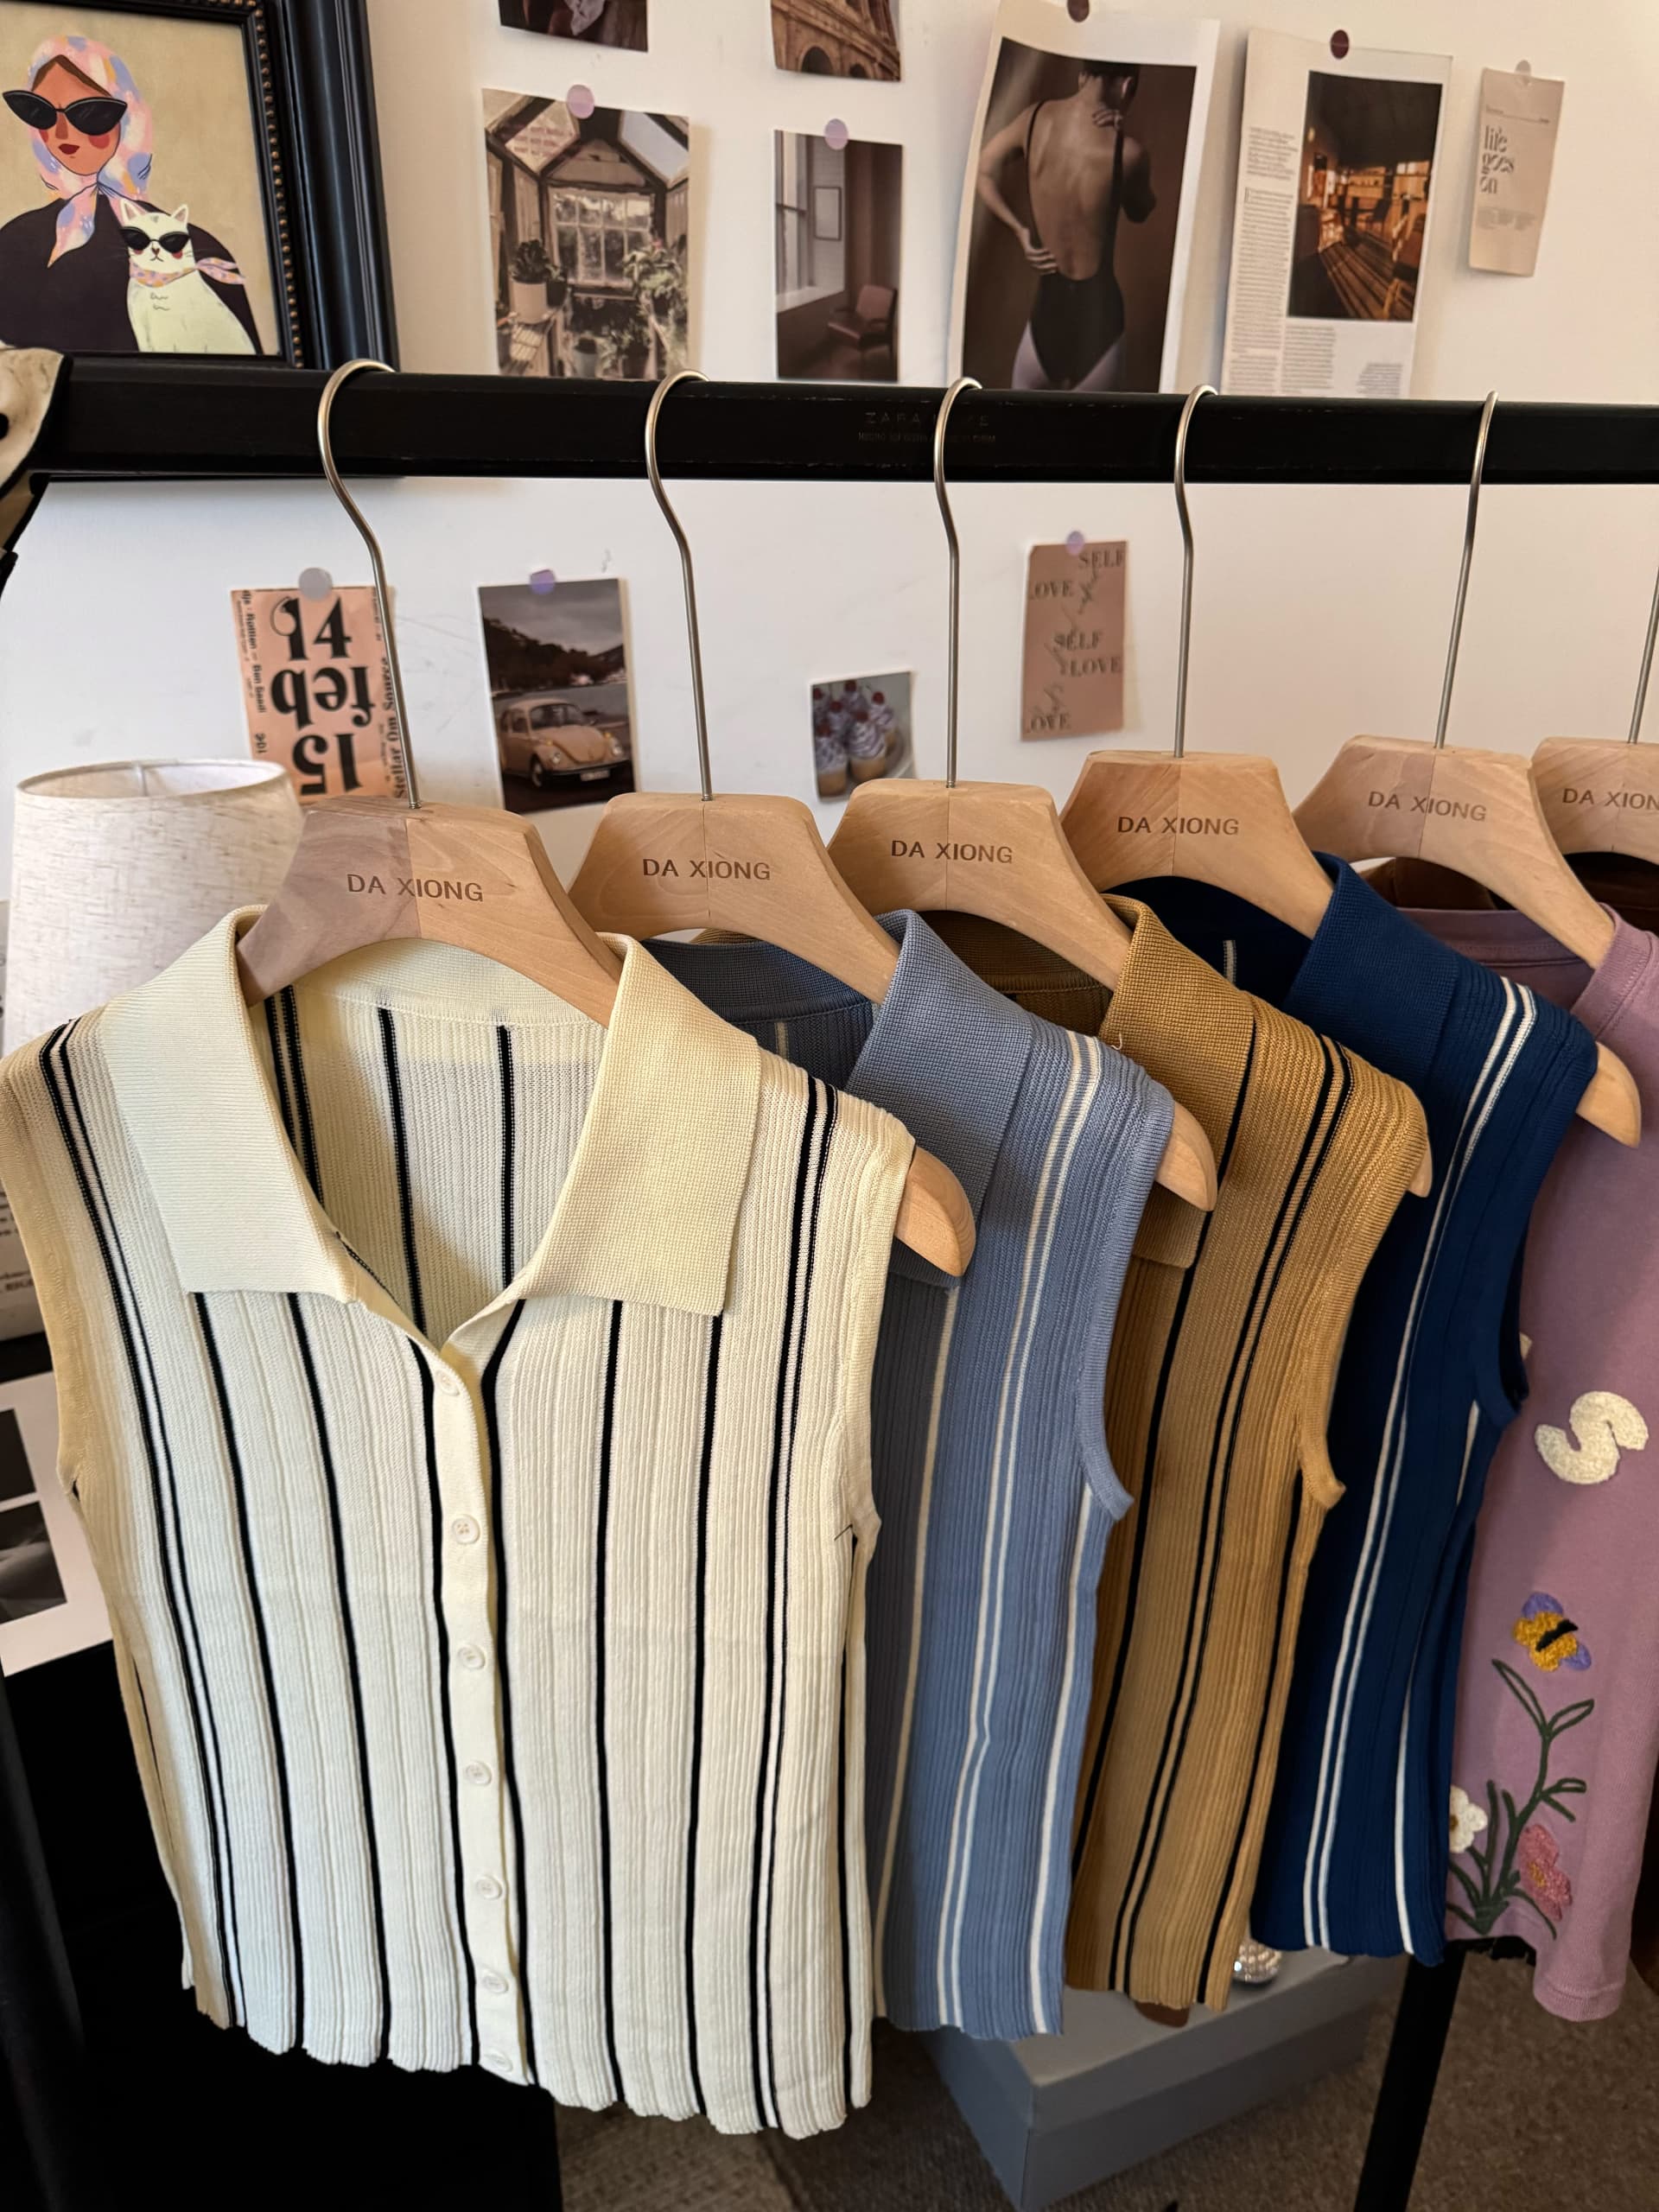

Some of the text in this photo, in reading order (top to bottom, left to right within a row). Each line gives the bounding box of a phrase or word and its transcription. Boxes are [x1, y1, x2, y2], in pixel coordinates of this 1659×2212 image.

[1484, 125, 1508, 154] life
[1481, 153, 1514, 175] goes
[1478, 175, 1497, 194] on
[1028, 579, 1074, 601] OVE
[270, 596, 352, 660] 14
[1026, 713, 1071, 734] OVE
[292, 732, 363, 796] 15
[1368, 791, 1487, 822] DA XIONG
[1561, 787, 1595, 805] DA
[1117, 817, 1239, 836] DA XIONG
[891, 840, 1013, 863] DA XIONG
[642, 858, 772, 880] DA XIONG
[346, 874, 484, 903] DA XIONG
